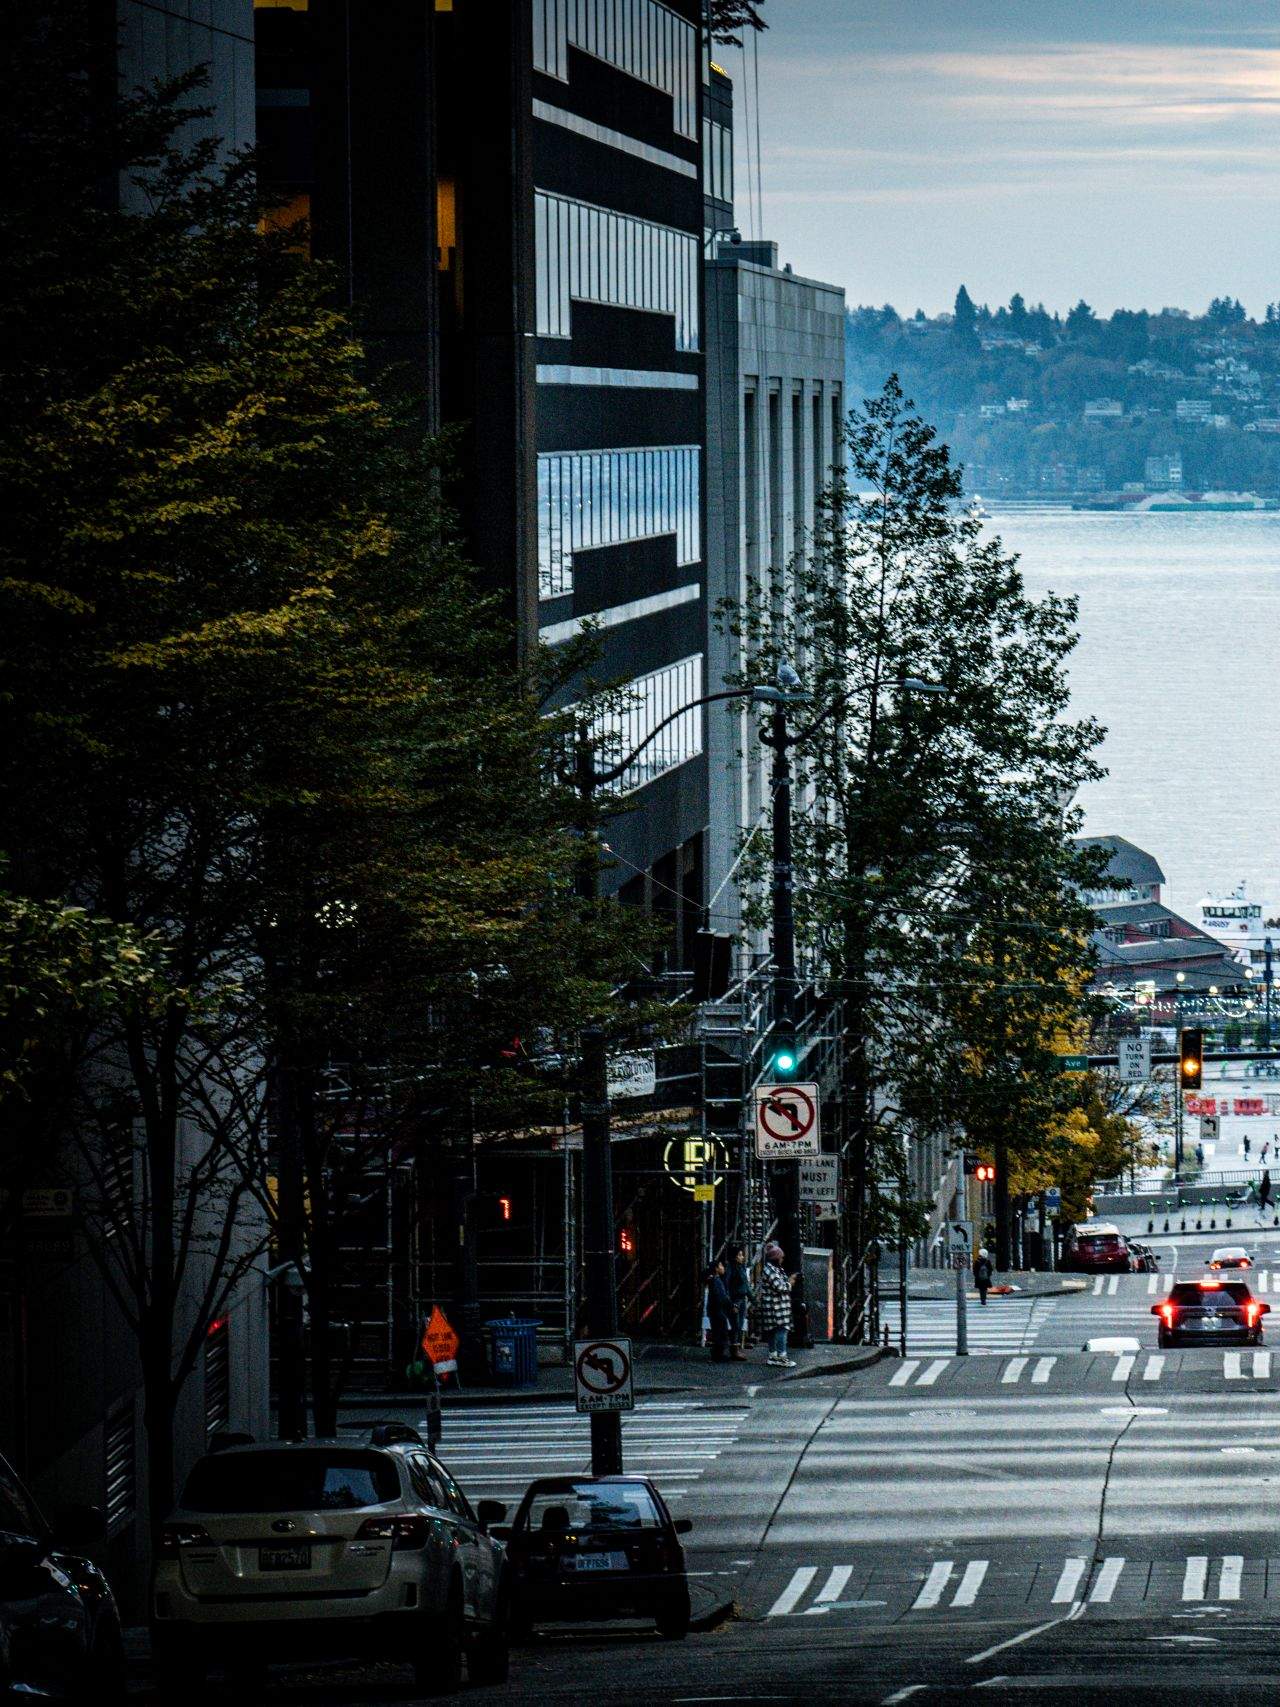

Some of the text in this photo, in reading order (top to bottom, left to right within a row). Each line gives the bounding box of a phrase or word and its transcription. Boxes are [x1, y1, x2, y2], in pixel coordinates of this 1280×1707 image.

[1127, 1043, 1143, 1052] NO
[801, 1172, 827, 1182] MUST
[816, 1187, 835, 1195] LEFT
